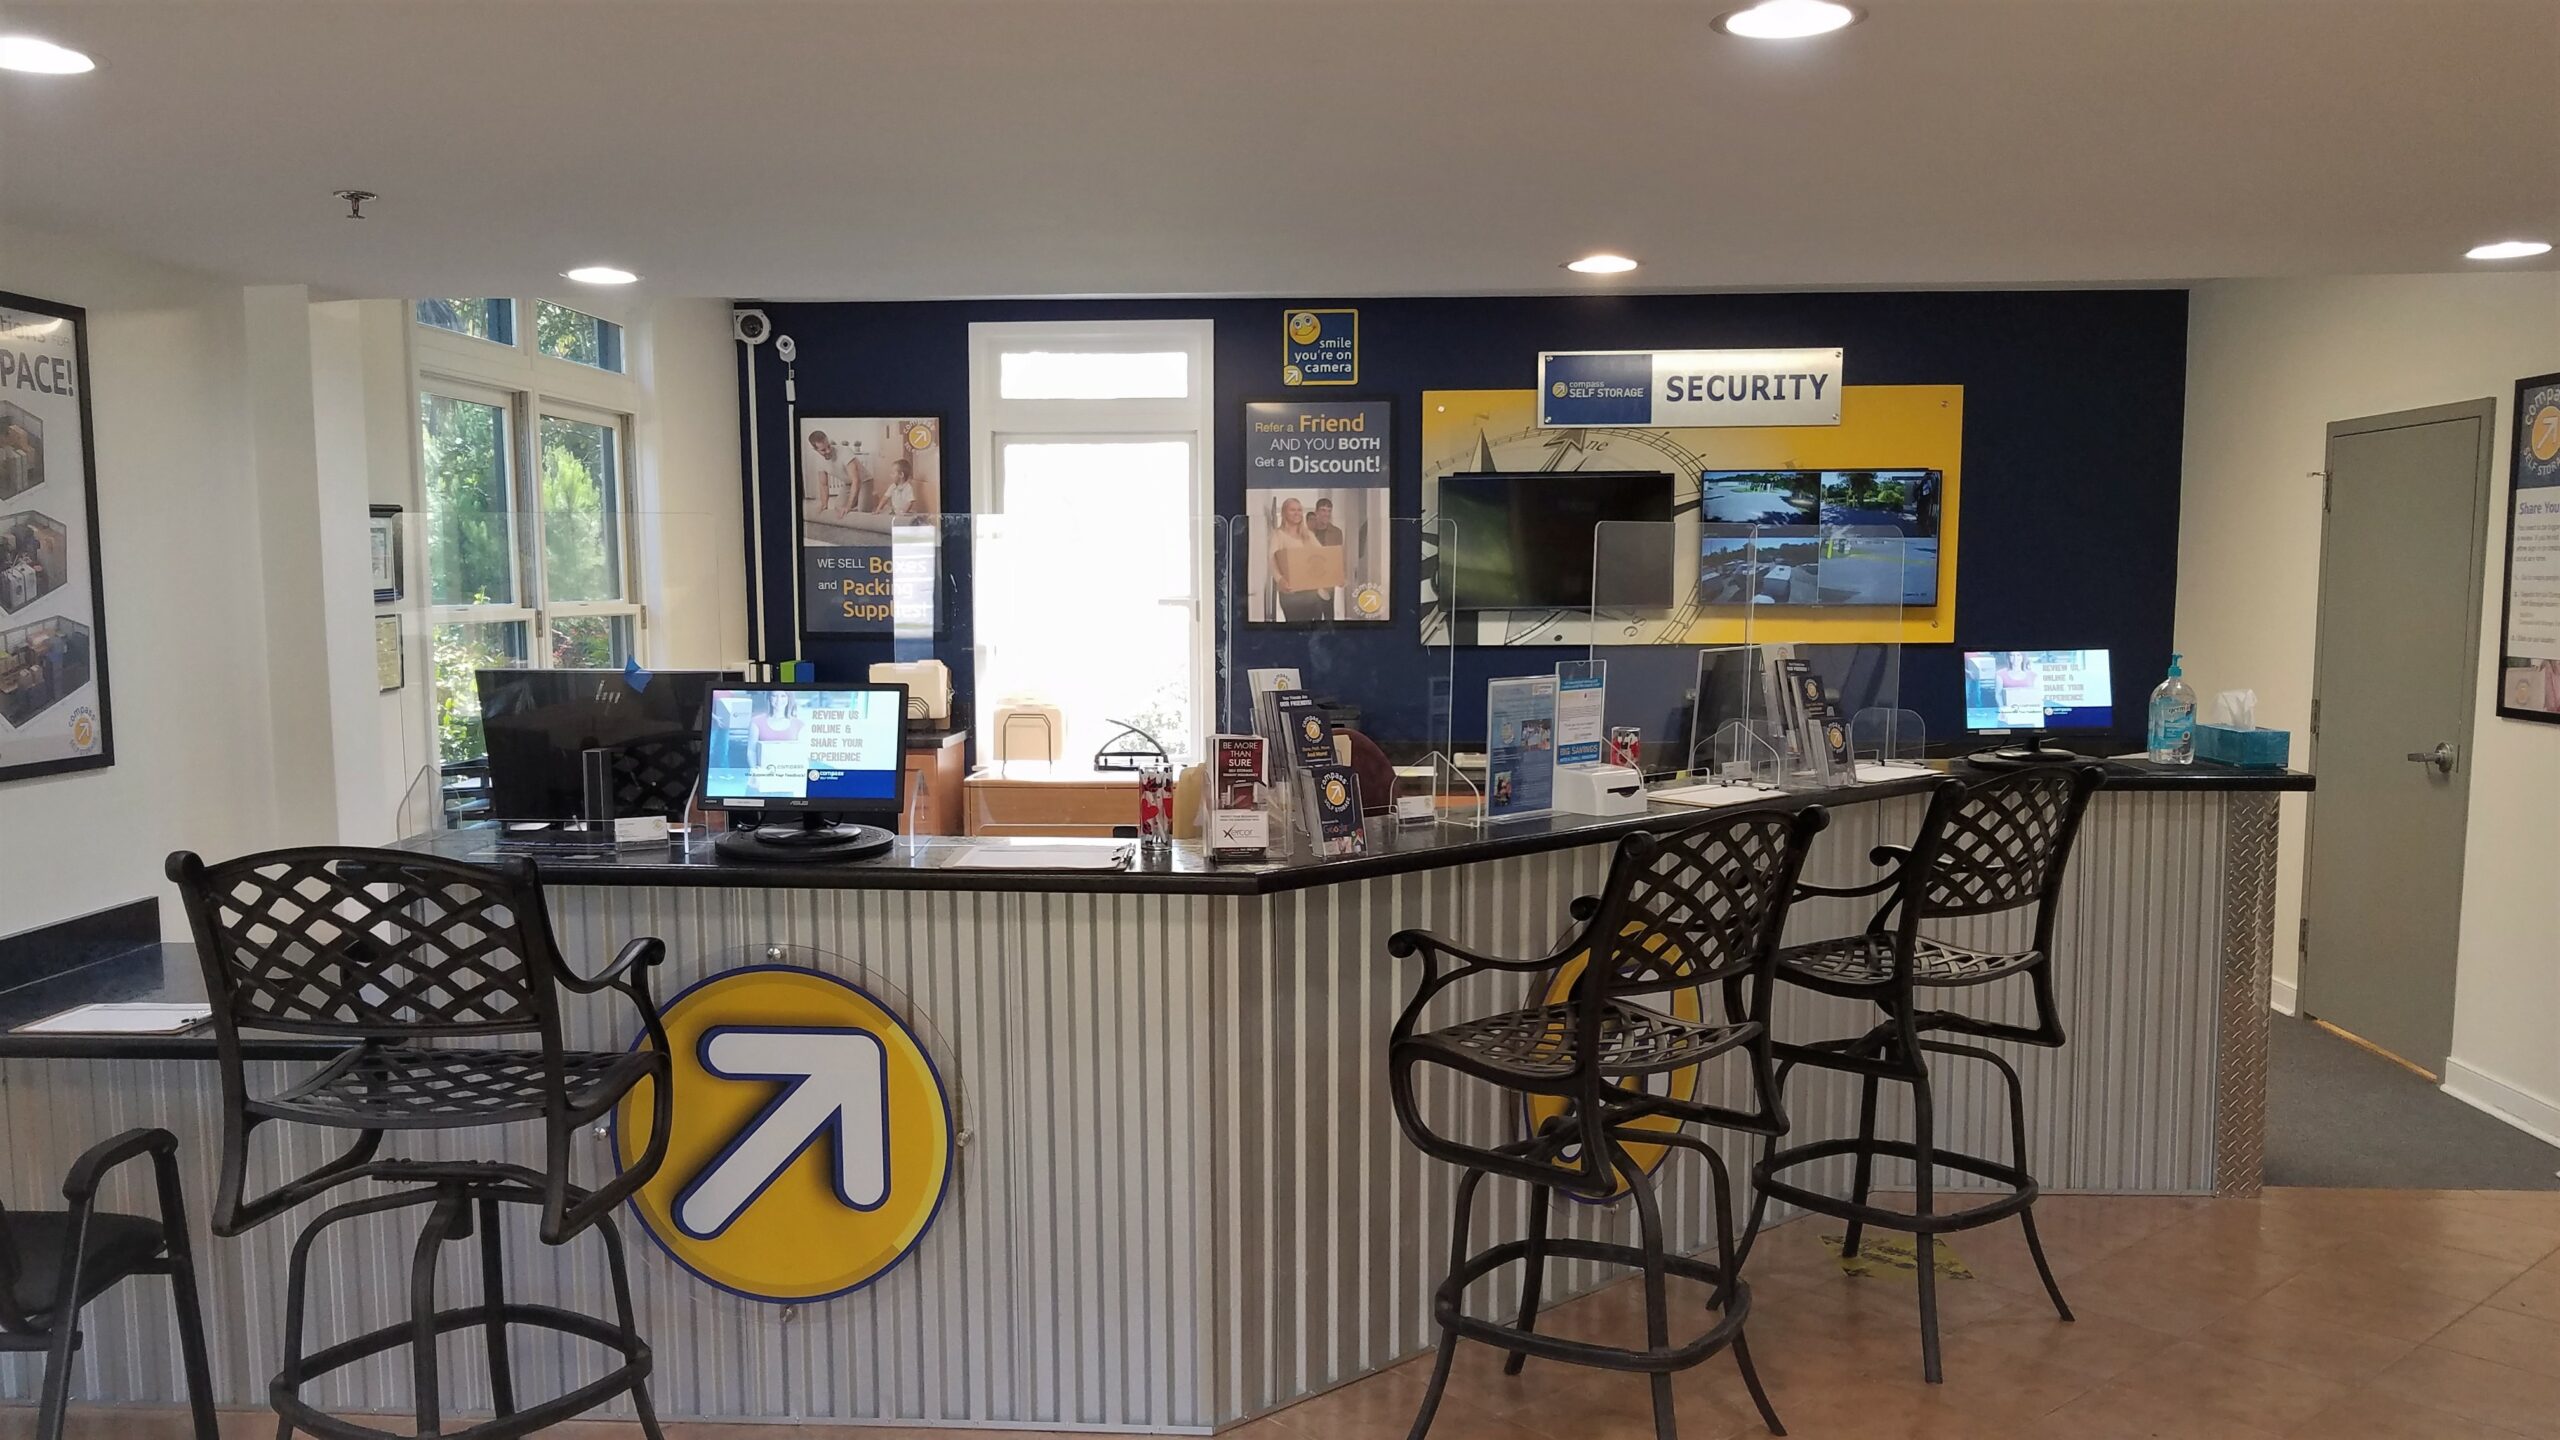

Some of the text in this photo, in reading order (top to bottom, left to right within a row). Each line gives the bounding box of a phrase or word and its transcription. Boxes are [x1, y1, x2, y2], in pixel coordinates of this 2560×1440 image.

[1319, 337, 1352, 348] smile
[1294, 350, 1352, 363] you're on
[1304, 363, 1352, 373] camera
[1569, 381, 1605, 389] compass
[1666, 373, 1829, 402] SECURITY
[1569, 387, 1644, 398] SELF STORAGE
[1255, 412, 1365, 433] Refer a Friend
[1270, 437, 1380, 451] AND YOU BOTH
[1255, 455, 1380, 473] Get a Discount!
[2519, 502, 2542, 515] Share
[817, 558, 836, 568] WE
[838, 558, 865, 568] SELL
[818, 581, 838, 590] and
[812, 710, 859, 720] REVIEW US
[811, 724, 852, 734] ONLINE &
[810, 738, 863, 748] SHARE YOUR
[1222, 741, 1259, 750] BE MORE
[809, 751, 862, 762] EXPERIENCE
[1230, 750, 1252, 758] THAN
[1228, 758, 1253, 767] SURE
[1321, 772, 1346, 790] compass
